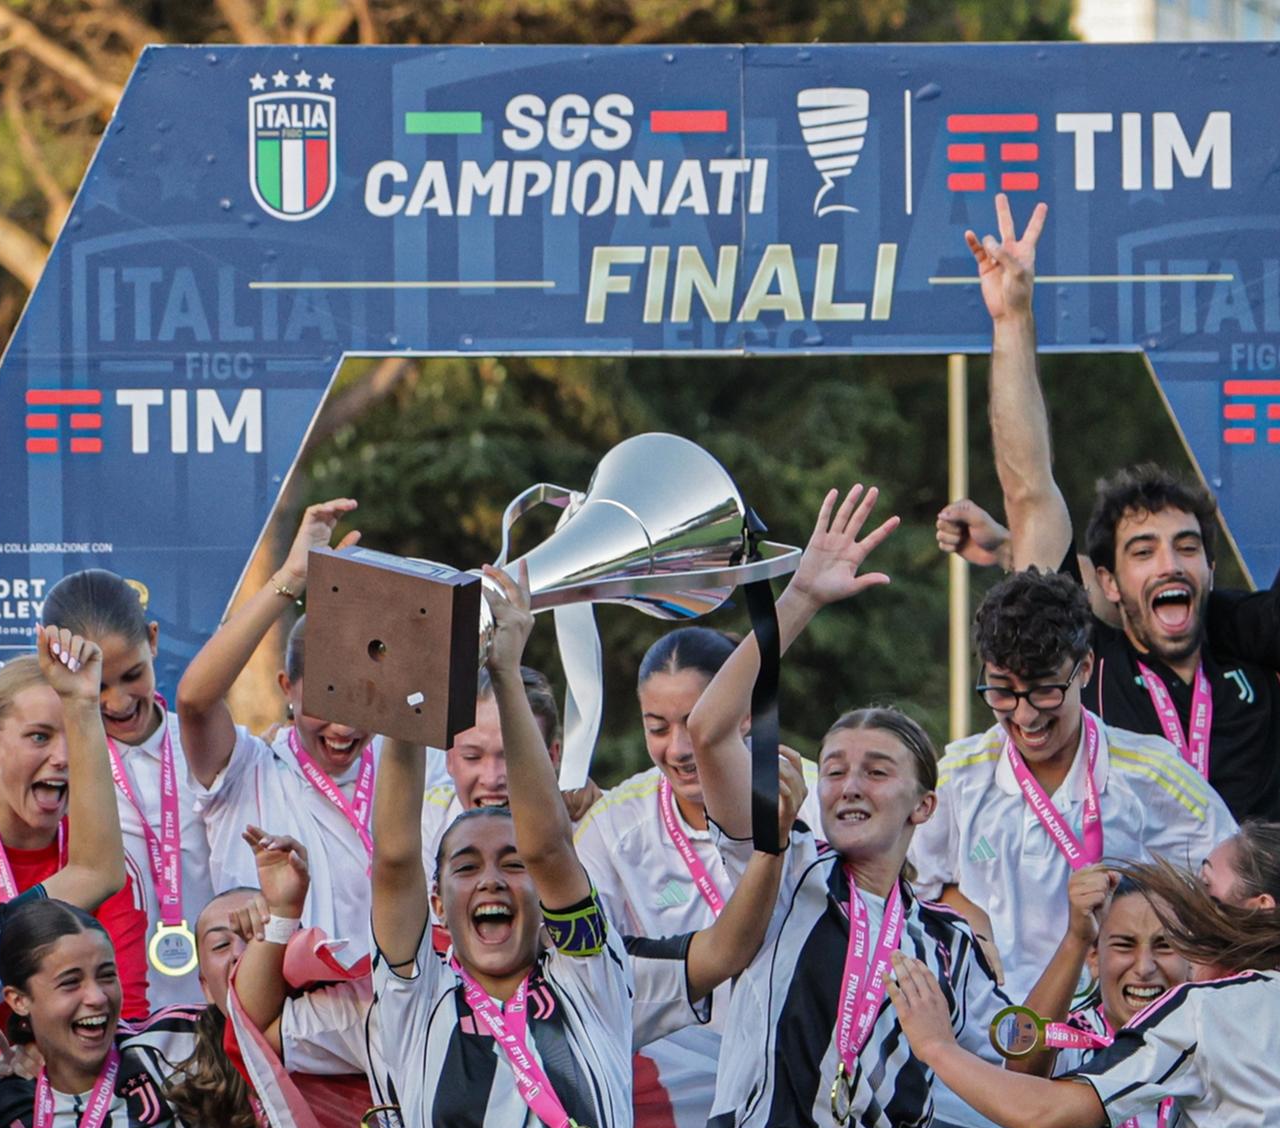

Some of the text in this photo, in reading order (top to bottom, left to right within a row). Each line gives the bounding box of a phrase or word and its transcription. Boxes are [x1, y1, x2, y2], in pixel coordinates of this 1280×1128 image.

[256, 103, 329, 129] ITALIA
[503, 93, 633, 152] SGS
[1055, 111, 1233, 192] TIM
[364, 157, 768, 218] CAMPIONATI
[586, 243, 899, 324] FINALI
[184, 351, 254, 381] FIGC
[116, 389, 263, 454] TIM
[4, 543, 90, 553] COLLABORAZIONE
[92, 543, 113, 553] CON
[303, 763, 330, 794] FINALI
[166, 812, 174, 829] TIM
[1022, 779, 1080, 860] FINALI NAZIONALI
[674, 832, 696, 864] FINALI
[854, 939, 864, 957] TIM
[844, 973, 859, 1009] FINALI
[90, 1061, 119, 1120] NAZIONALI
